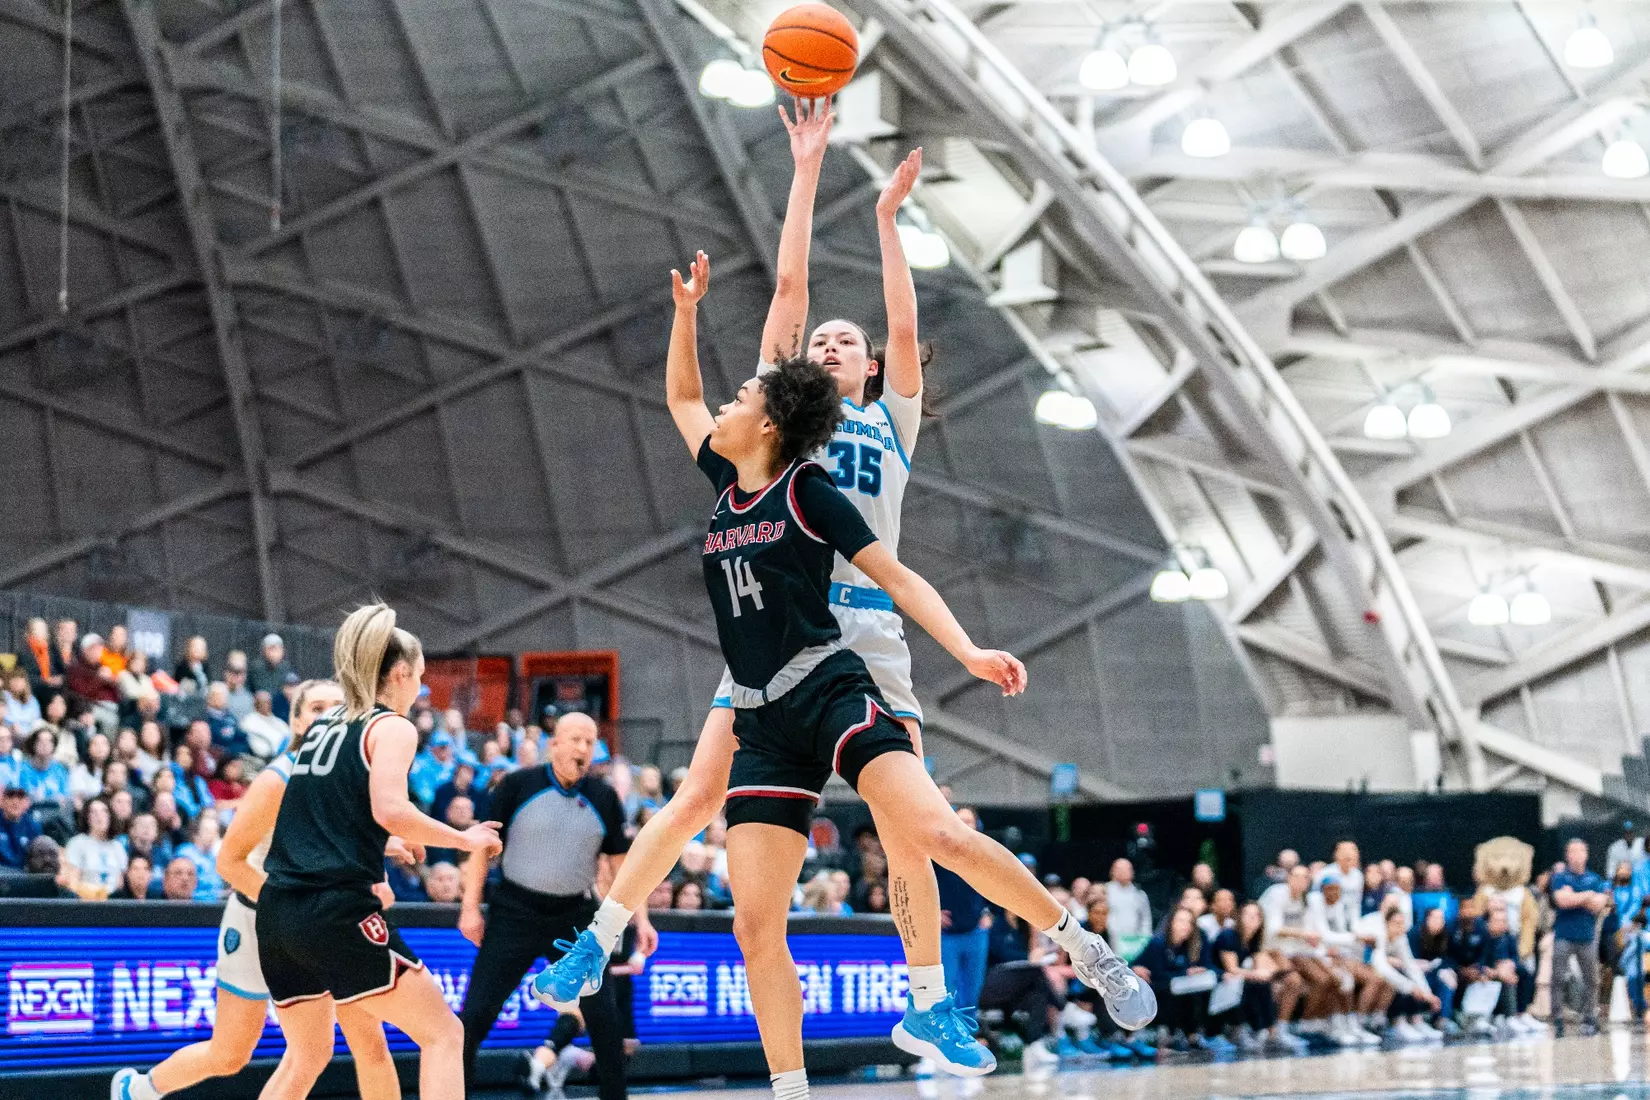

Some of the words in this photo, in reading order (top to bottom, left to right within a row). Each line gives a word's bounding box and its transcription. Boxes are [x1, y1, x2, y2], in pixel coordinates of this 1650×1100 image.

[827, 440, 883, 497] 35
[703, 520, 786, 555] HARVARD
[720, 556, 765, 618] 14
[292, 724, 348, 776] 20
